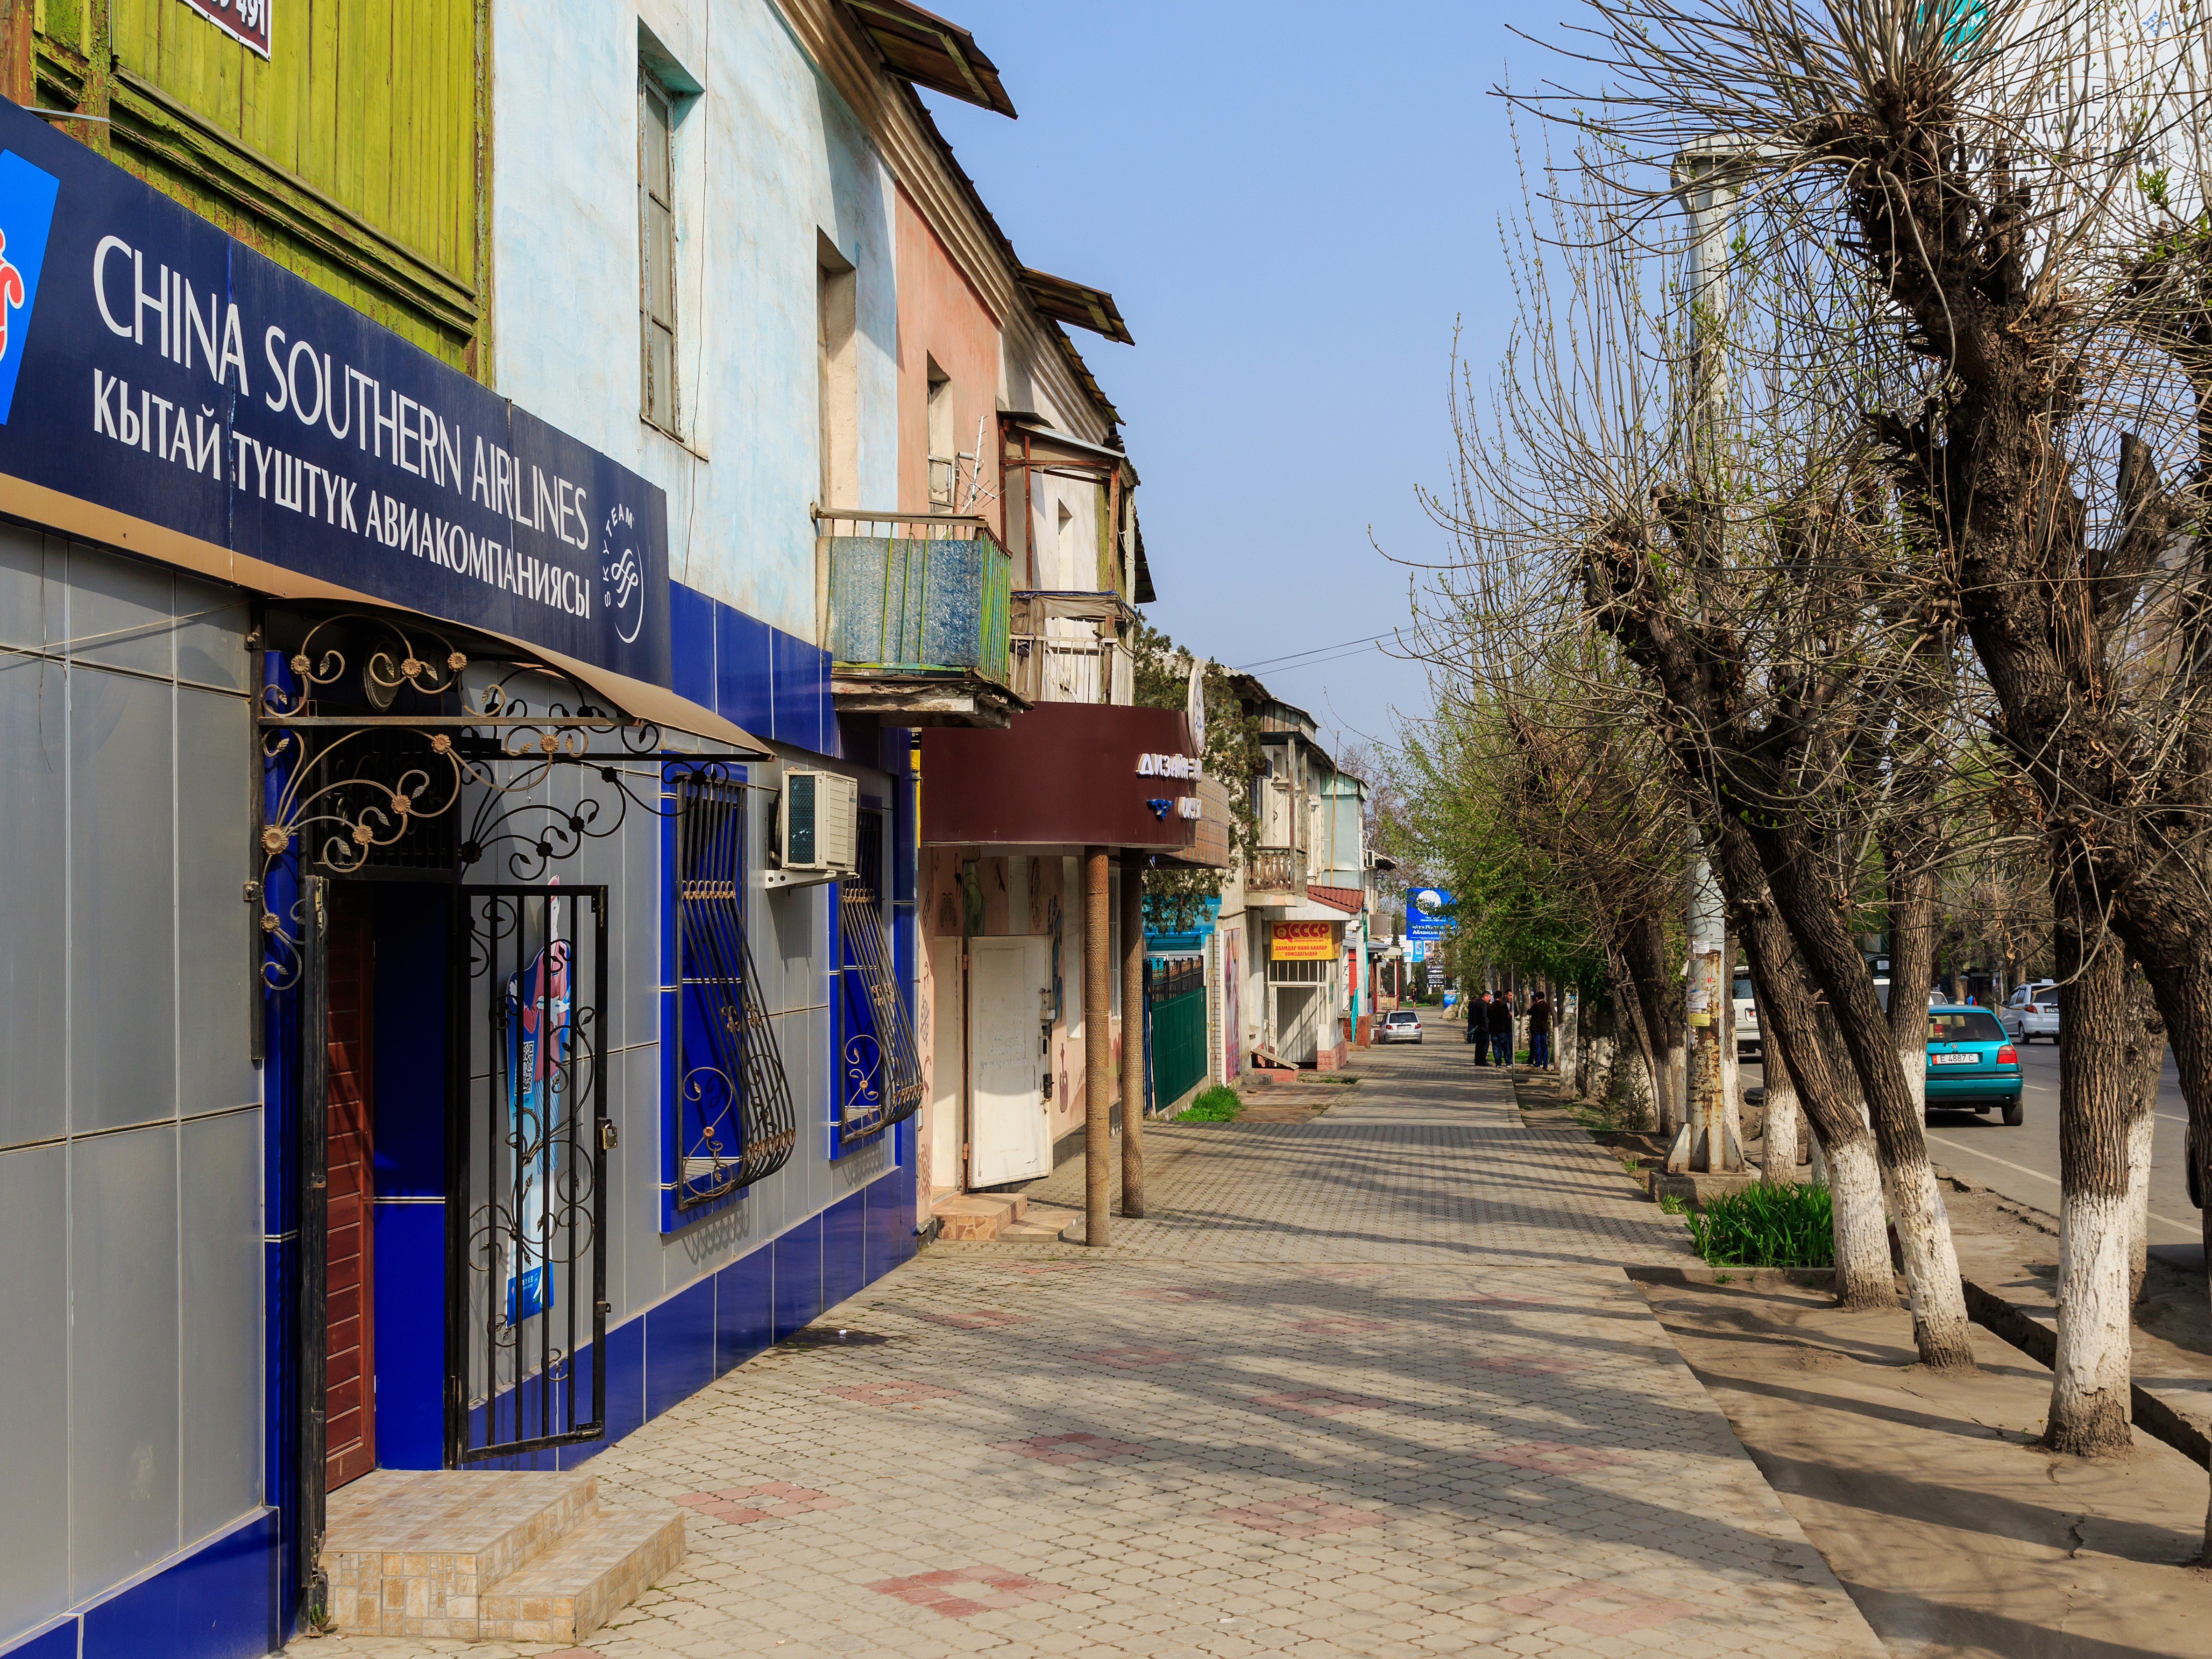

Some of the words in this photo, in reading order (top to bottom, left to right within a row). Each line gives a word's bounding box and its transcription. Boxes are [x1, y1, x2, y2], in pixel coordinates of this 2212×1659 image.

[93, 235, 249, 397] CHINA
[265, 325, 462, 495] SOUTHERN
[472, 435, 589, 550] AIRLINES
[94, 368, 221, 481] КЫТАЙ
[365, 490, 590, 619] АВИАКОМПАНИЯСЫ
[1290, 923, 1329, 937] СССР
